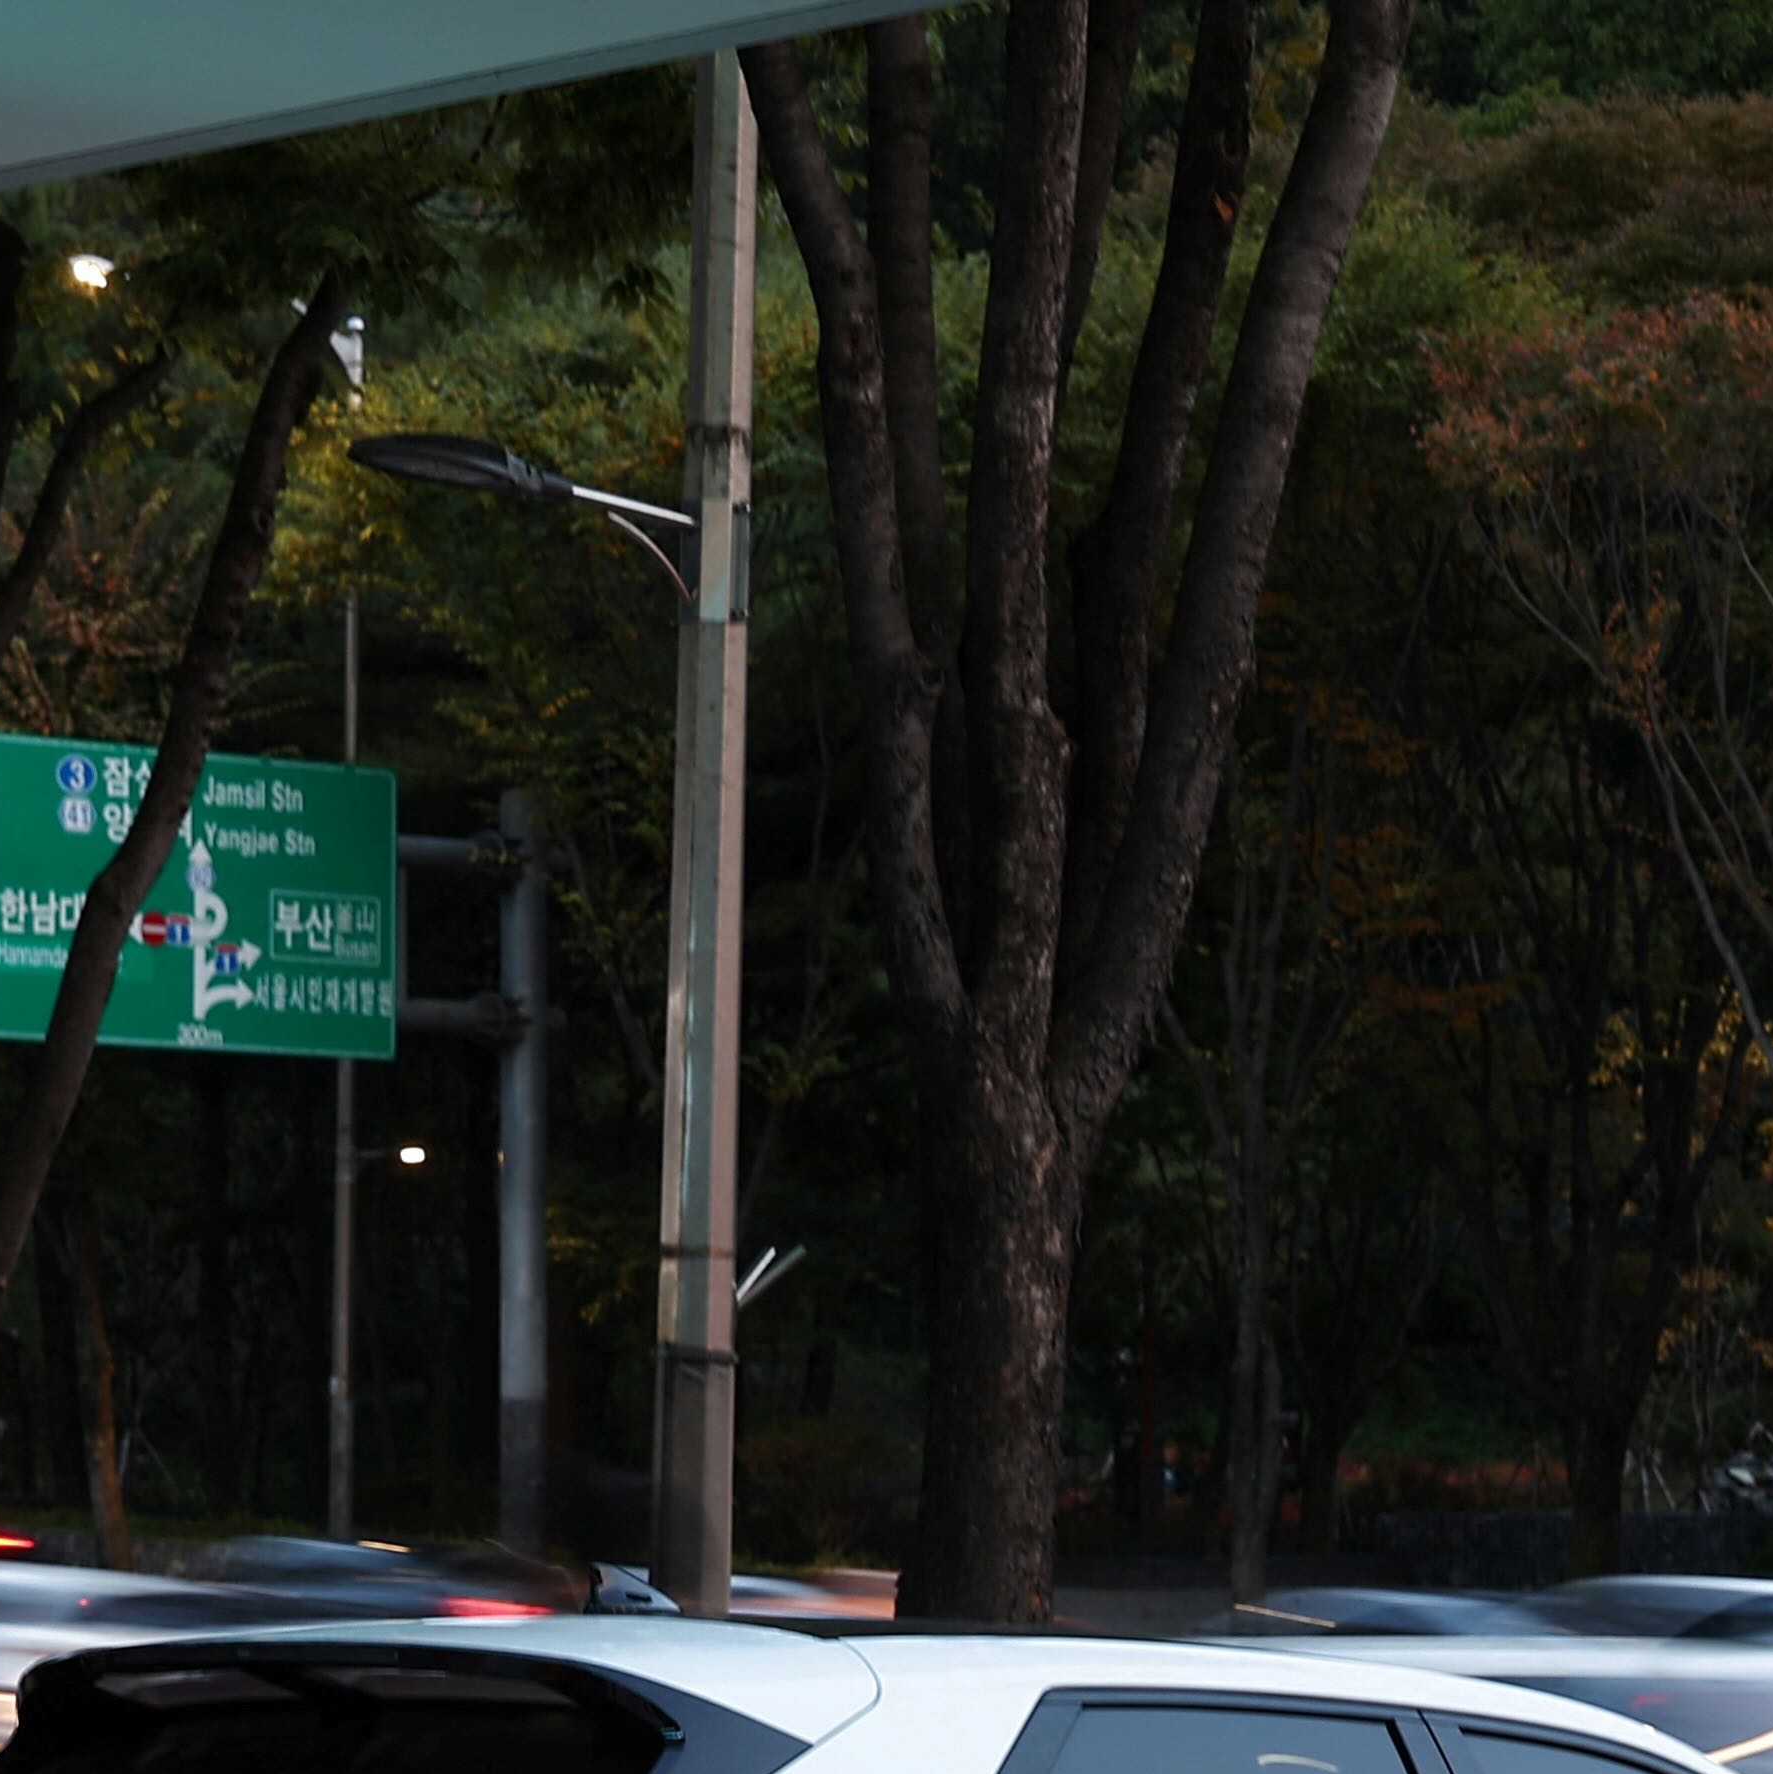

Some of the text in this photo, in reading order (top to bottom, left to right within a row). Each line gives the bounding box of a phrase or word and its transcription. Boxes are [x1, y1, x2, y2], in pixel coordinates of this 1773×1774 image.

[69, 760, 86, 791] 3
[202, 775, 304, 813] Jamsil Stn
[204, 821, 279, 858] Yangjae
[284, 827, 316, 856] Stn
[274, 900, 333, 952] 부산
